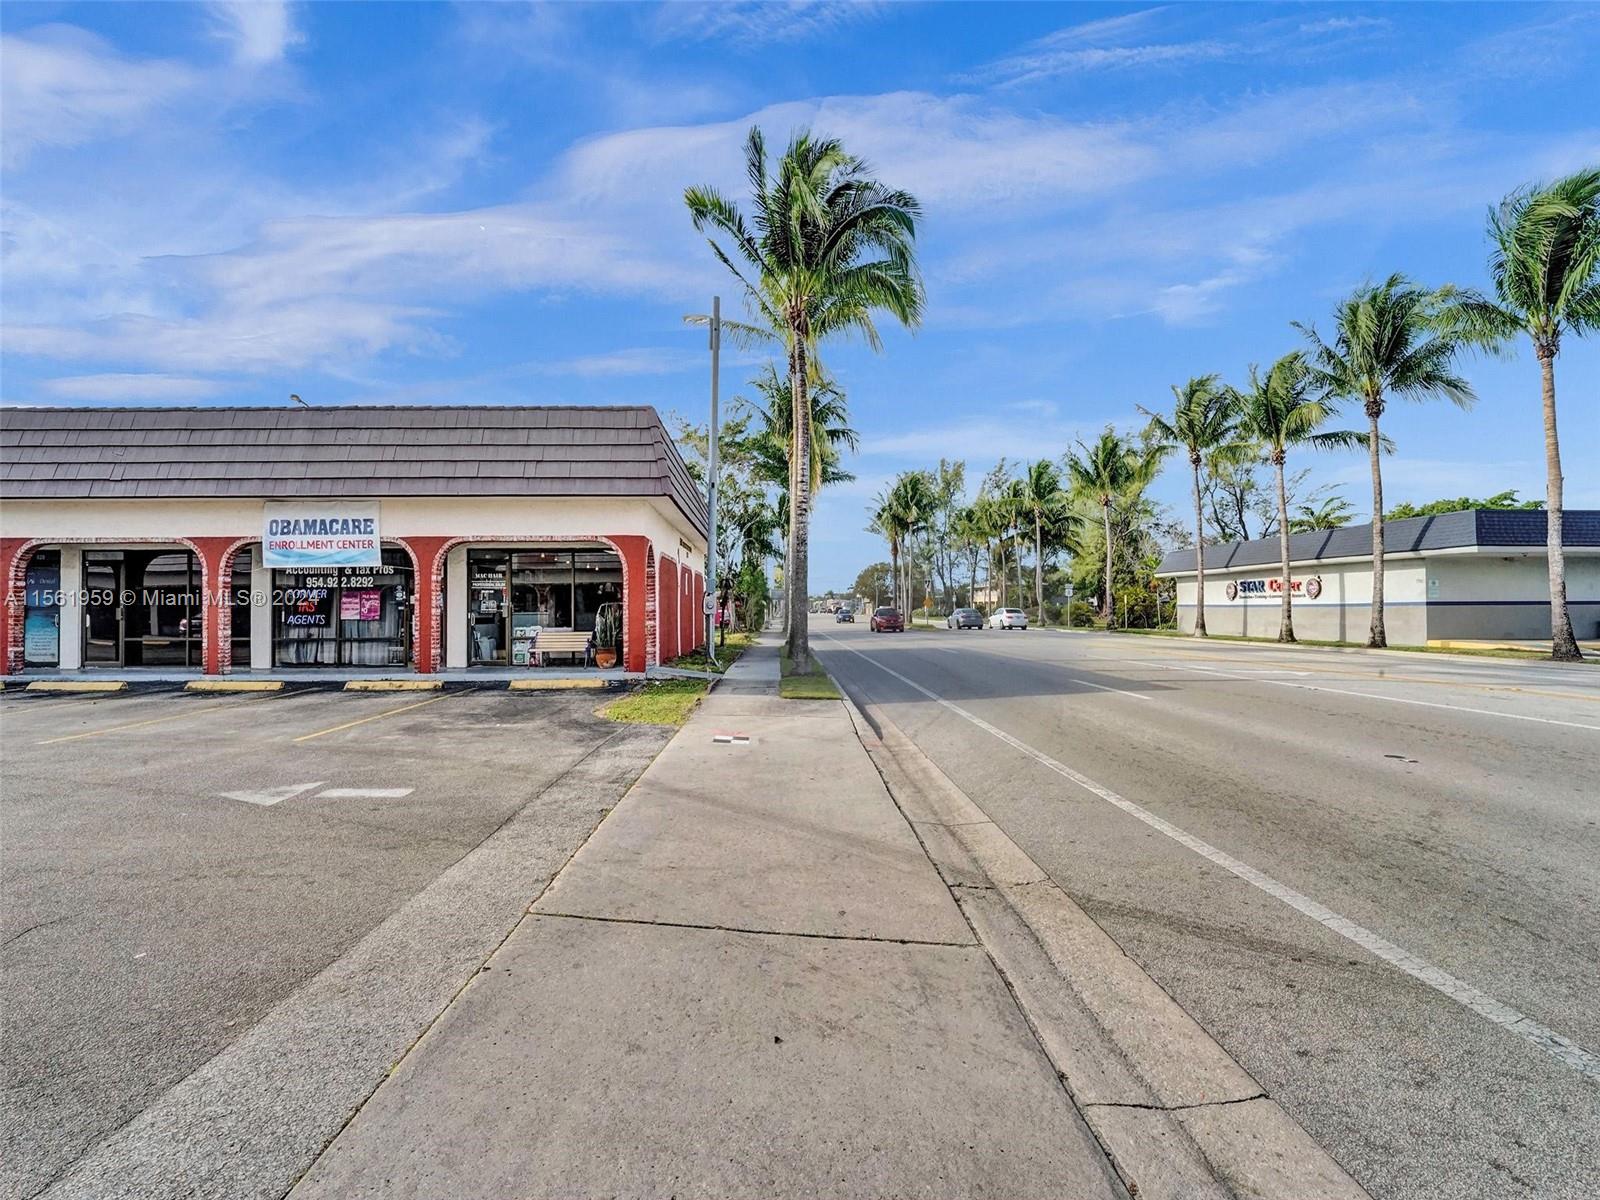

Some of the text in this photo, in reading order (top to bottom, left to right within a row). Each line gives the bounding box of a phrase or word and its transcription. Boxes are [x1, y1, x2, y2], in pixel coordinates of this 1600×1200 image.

[269, 518, 374, 536] OBAMACARE
[269, 540, 374, 551] ENROLLMENT CENTER
[286, 567, 338, 576] Accounting
[355, 567, 370, 575] Tax
[373, 566, 394, 574] Pros
[1239, 580, 1266, 593] STAR
[298, 600, 315, 613] IRS
[287, 615, 326, 625] AGENTS
